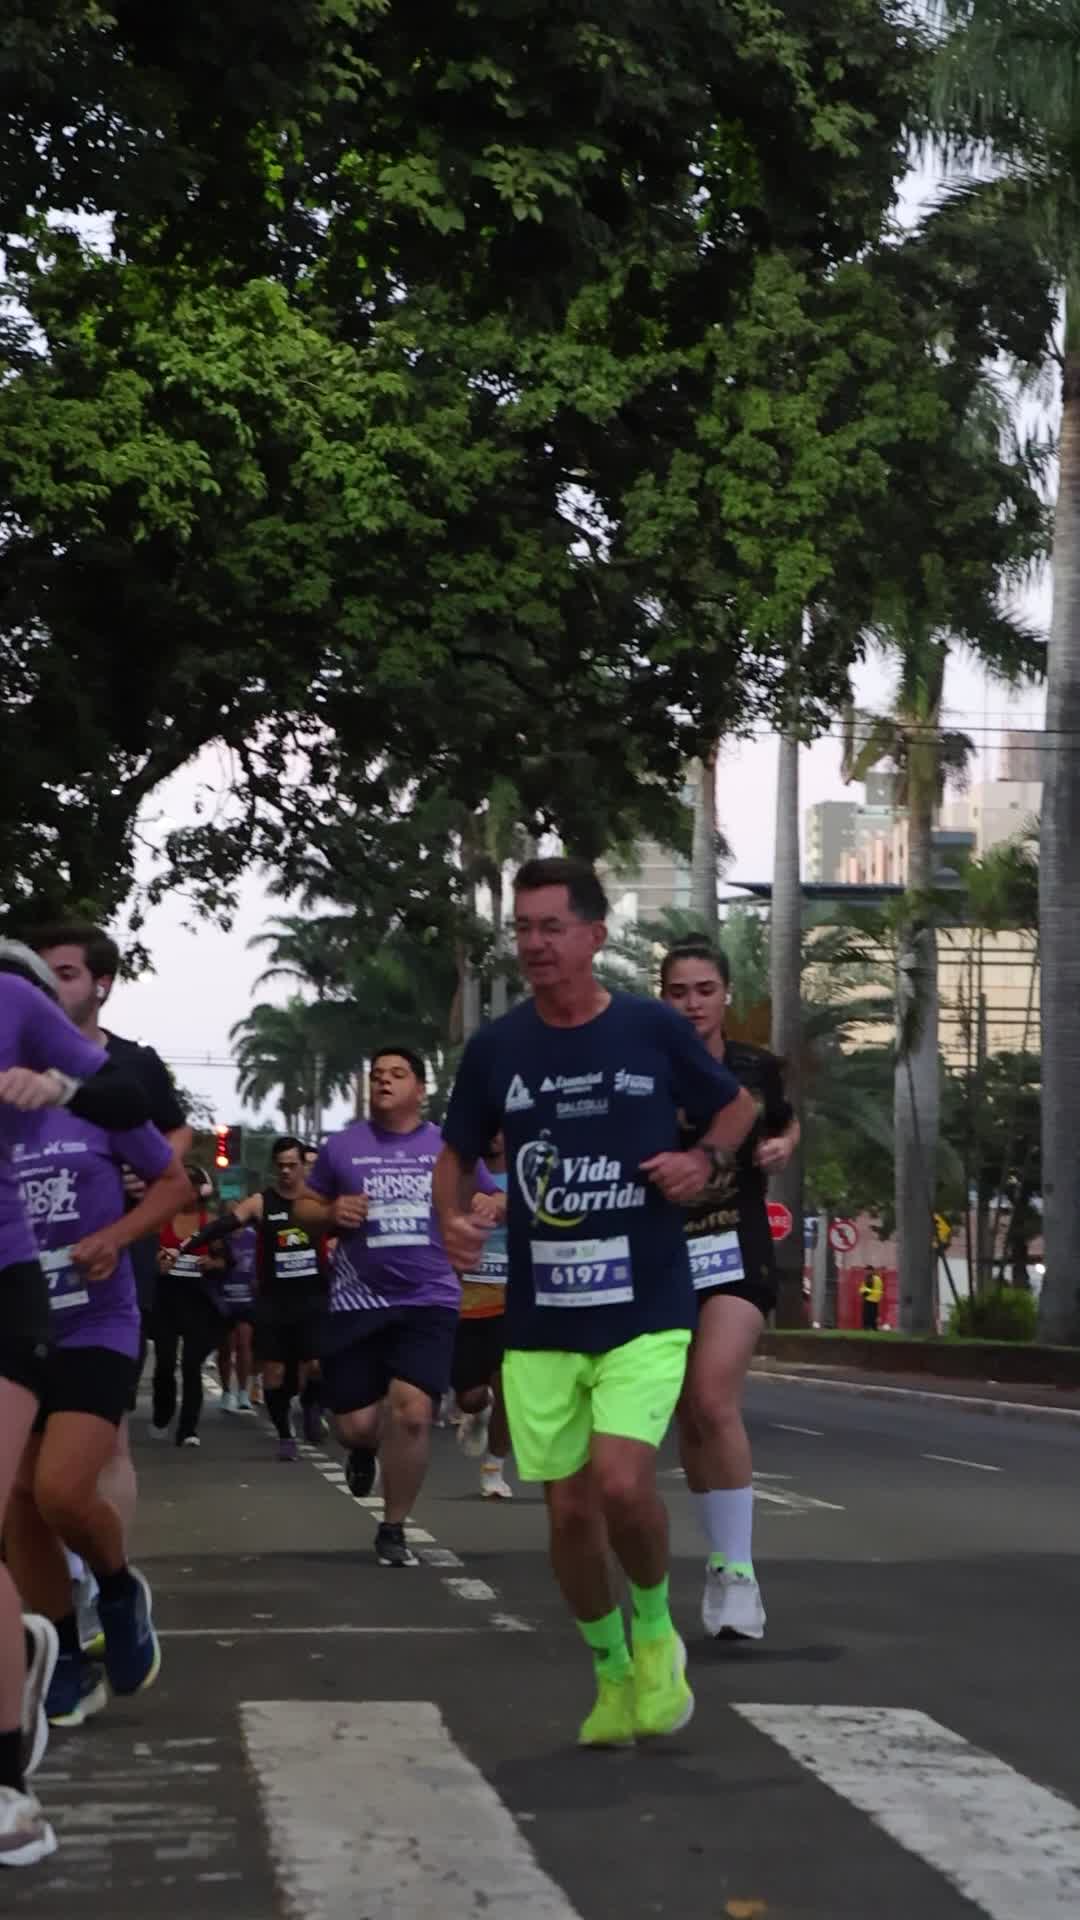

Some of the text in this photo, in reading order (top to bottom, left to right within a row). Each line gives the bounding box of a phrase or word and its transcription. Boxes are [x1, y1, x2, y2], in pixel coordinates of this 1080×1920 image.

[562, 1156, 621, 1184] Vida
[544, 1182, 646, 1214] Corrida
[768, 1215, 789, 1227] ARE
[550, 1263, 608, 1286] 6197
[688, 1253, 722, 1274] 394
